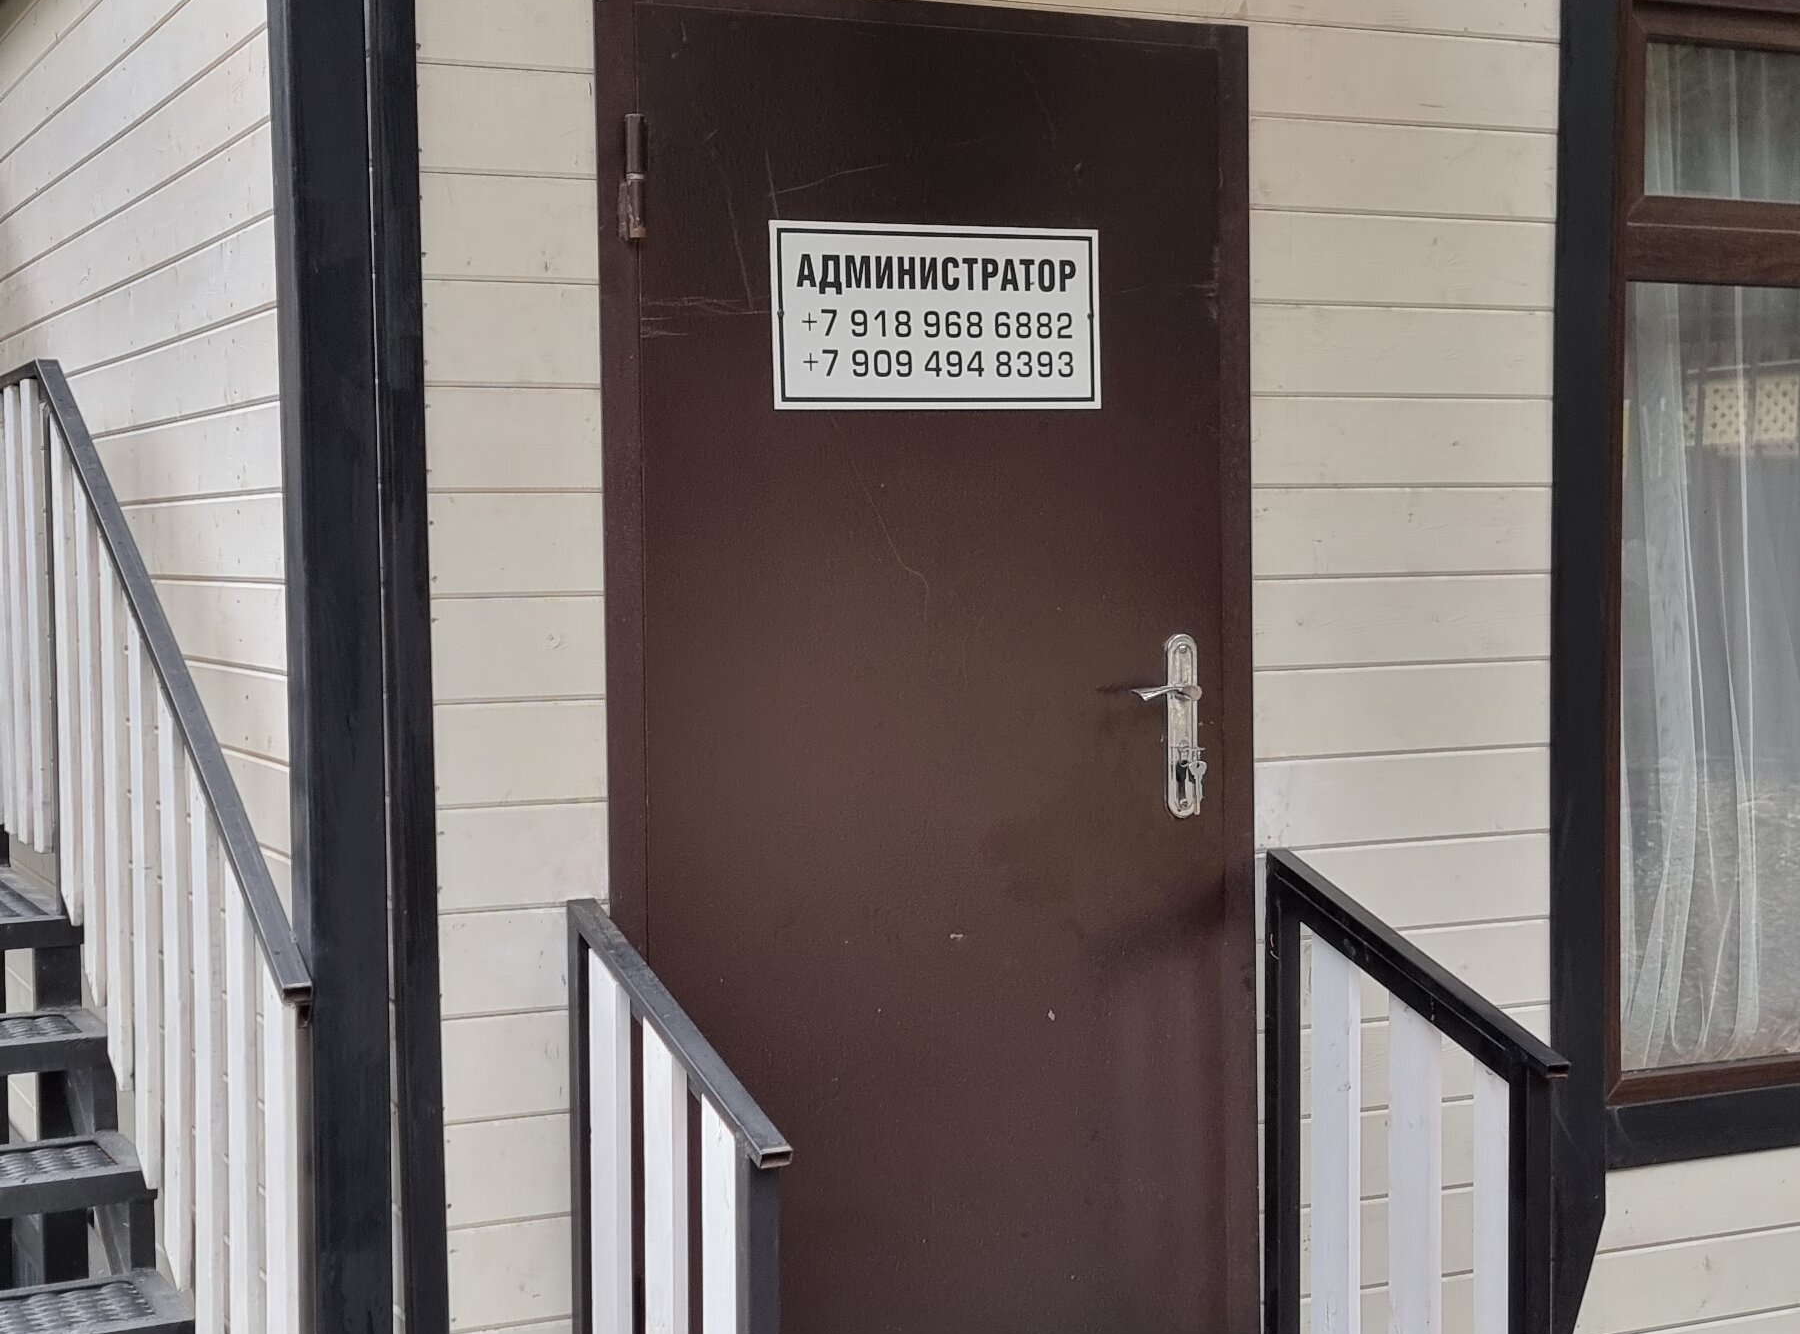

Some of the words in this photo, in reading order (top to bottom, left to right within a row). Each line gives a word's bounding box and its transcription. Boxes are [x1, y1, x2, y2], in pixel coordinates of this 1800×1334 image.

[796, 253, 1077, 295] АДМИНИСТРАТОР
[801, 309, 838, 337] +7
[850, 309, 912, 338] 918
[923, 310, 983, 339] 968
[994, 312, 1073, 340] 6882
[803, 349, 839, 377] +7
[851, 349, 913, 377] 909
[924, 350, 985, 378] 494
[995, 351, 1074, 379] 8393
